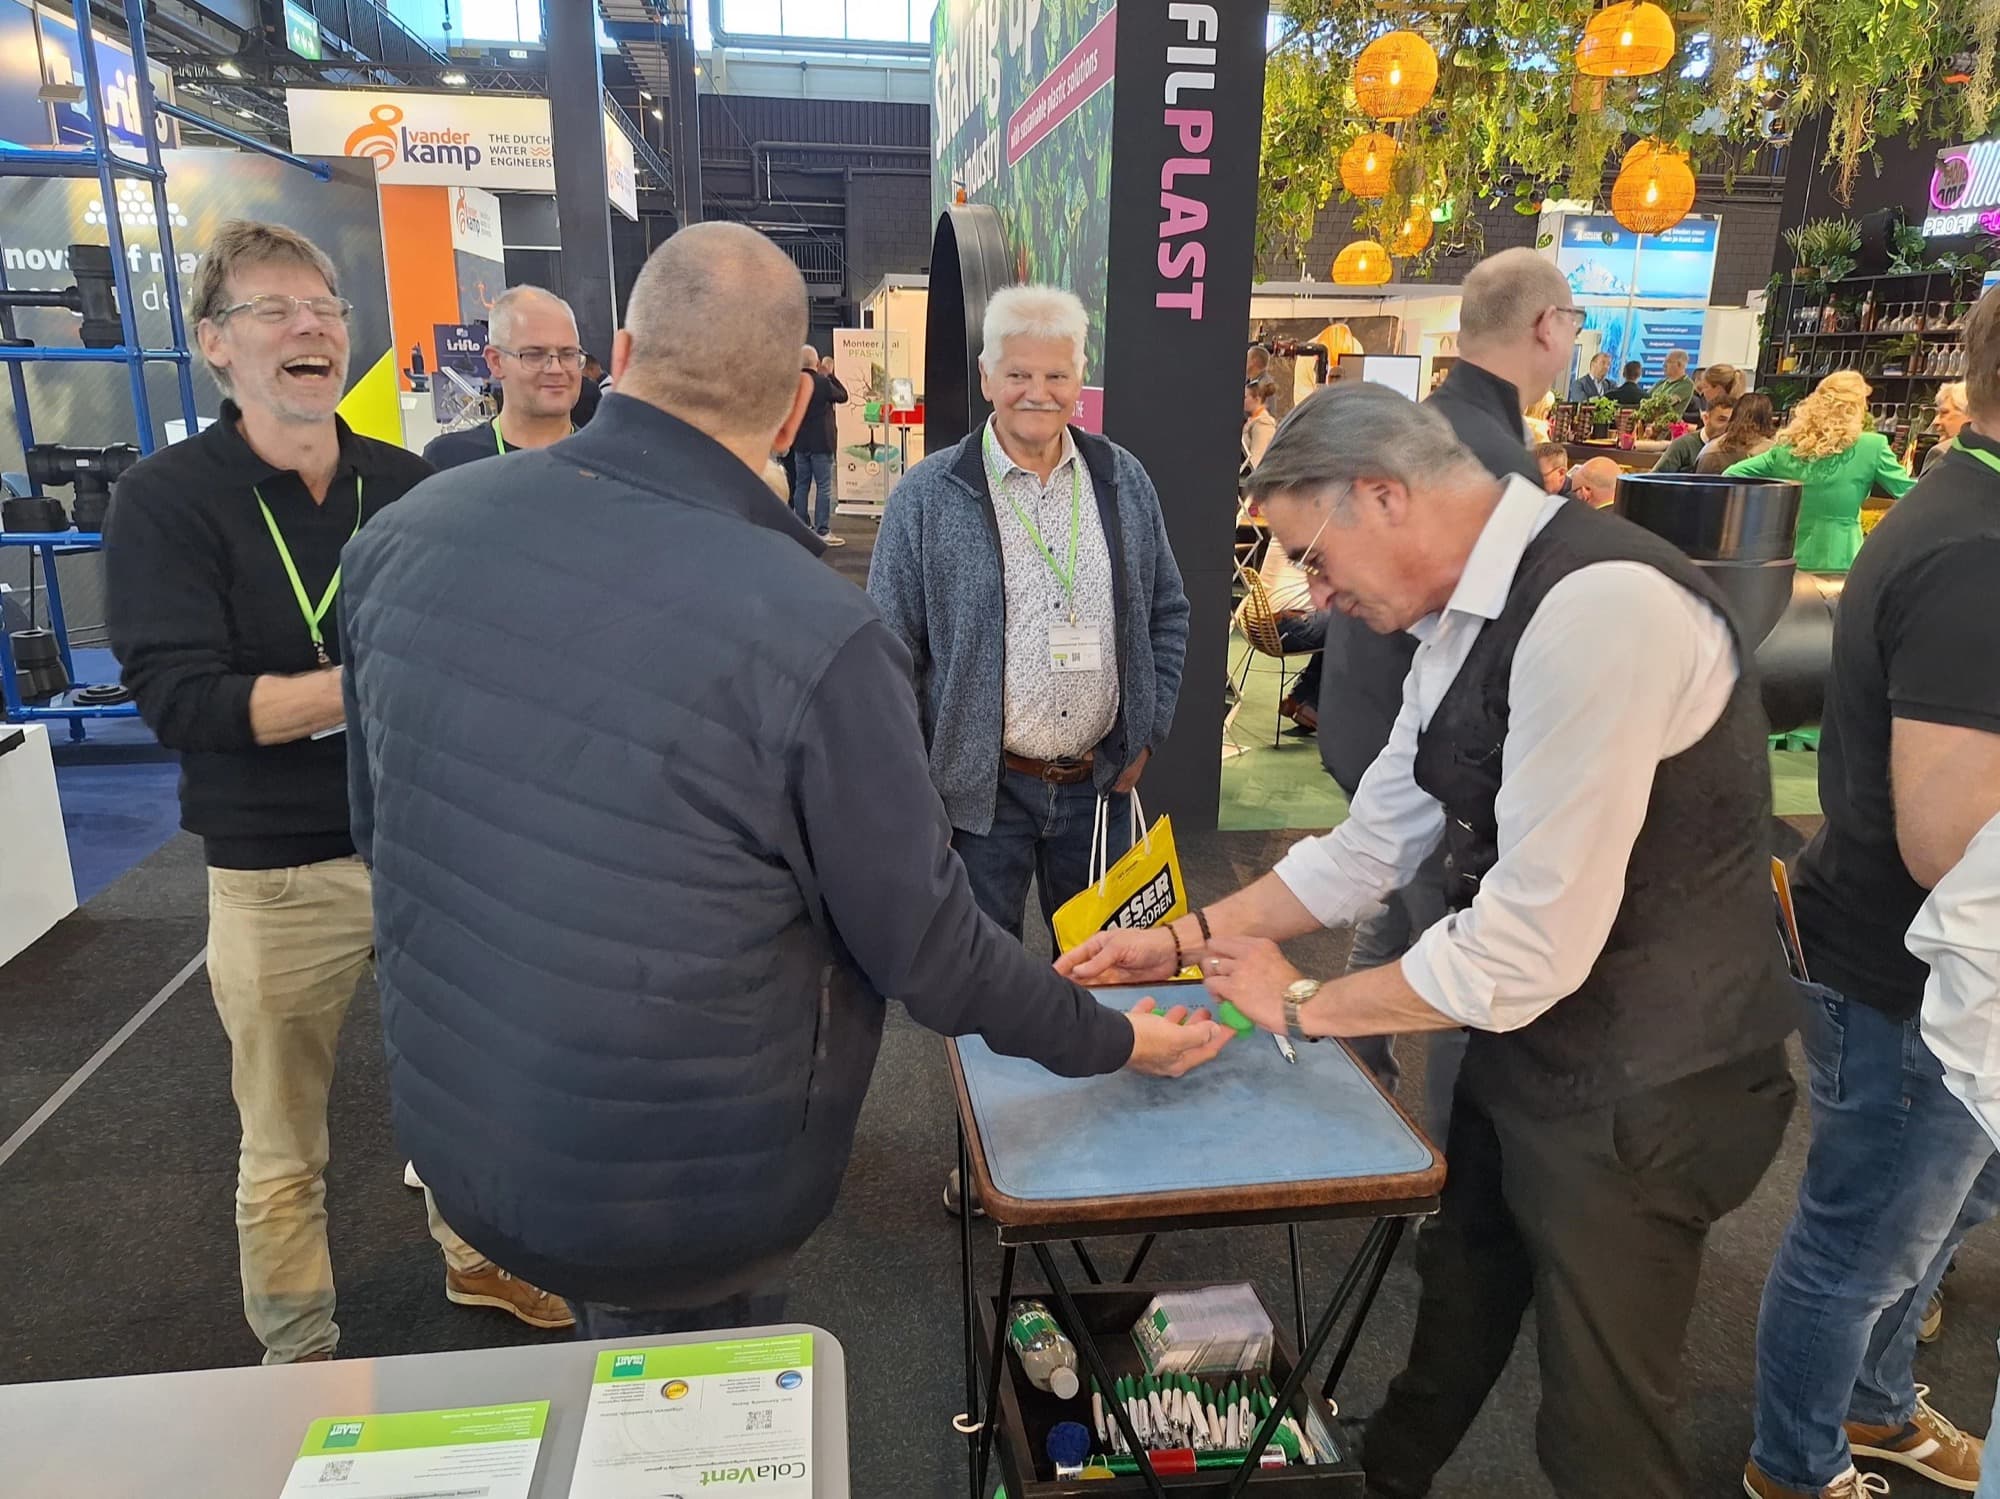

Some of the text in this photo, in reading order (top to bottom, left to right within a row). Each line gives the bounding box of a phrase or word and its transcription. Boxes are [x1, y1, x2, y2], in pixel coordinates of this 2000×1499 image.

[1020, 96, 1047, 141] sustainable
[1047, 75, 1067, 121] plastic
[1067, 48, 1098, 97] solutions
[409, 128, 470, 144] vander
[489, 133, 550, 145] THE DUTCH
[402, 126, 481, 170] kamp
[490, 146, 527, 156] WATER
[491, 157, 552, 168] ENGINEERS
[965, 124, 1000, 198] industry
[843, 339, 879, 348] Monteer
[700, 1461, 806, 1487] ColaVent
